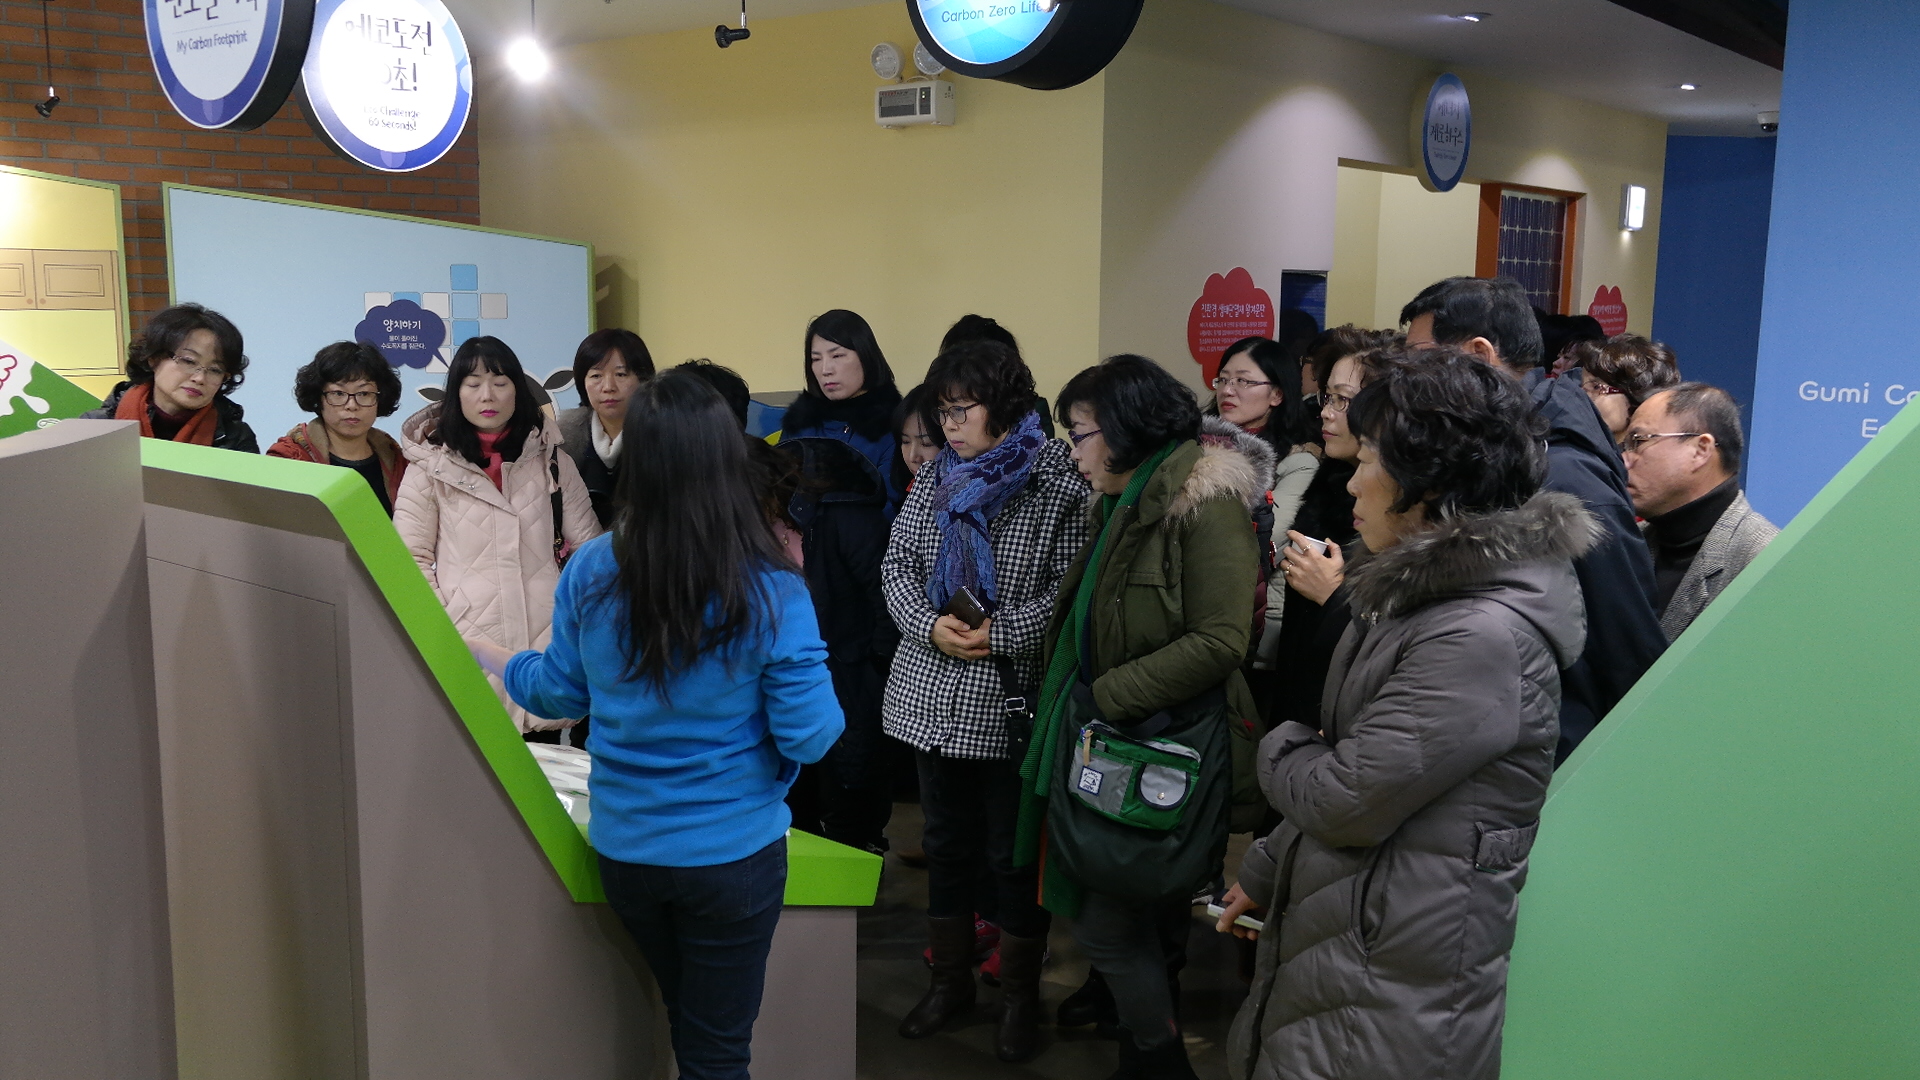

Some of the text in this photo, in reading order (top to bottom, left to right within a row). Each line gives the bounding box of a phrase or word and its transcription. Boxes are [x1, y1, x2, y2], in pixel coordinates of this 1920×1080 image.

[941, 9, 985, 23] Carbon
[989, 5, 1016, 18] Zero
[176, 30, 248, 55] My Carbon Footprint
[345, 13, 433, 56] 에코도전
[380, 105, 421, 121] Challenge
[383, 319, 421, 332] 양치하기
[1799, 380, 1870, 404] Gumi
[1861, 418, 1887, 438] E
